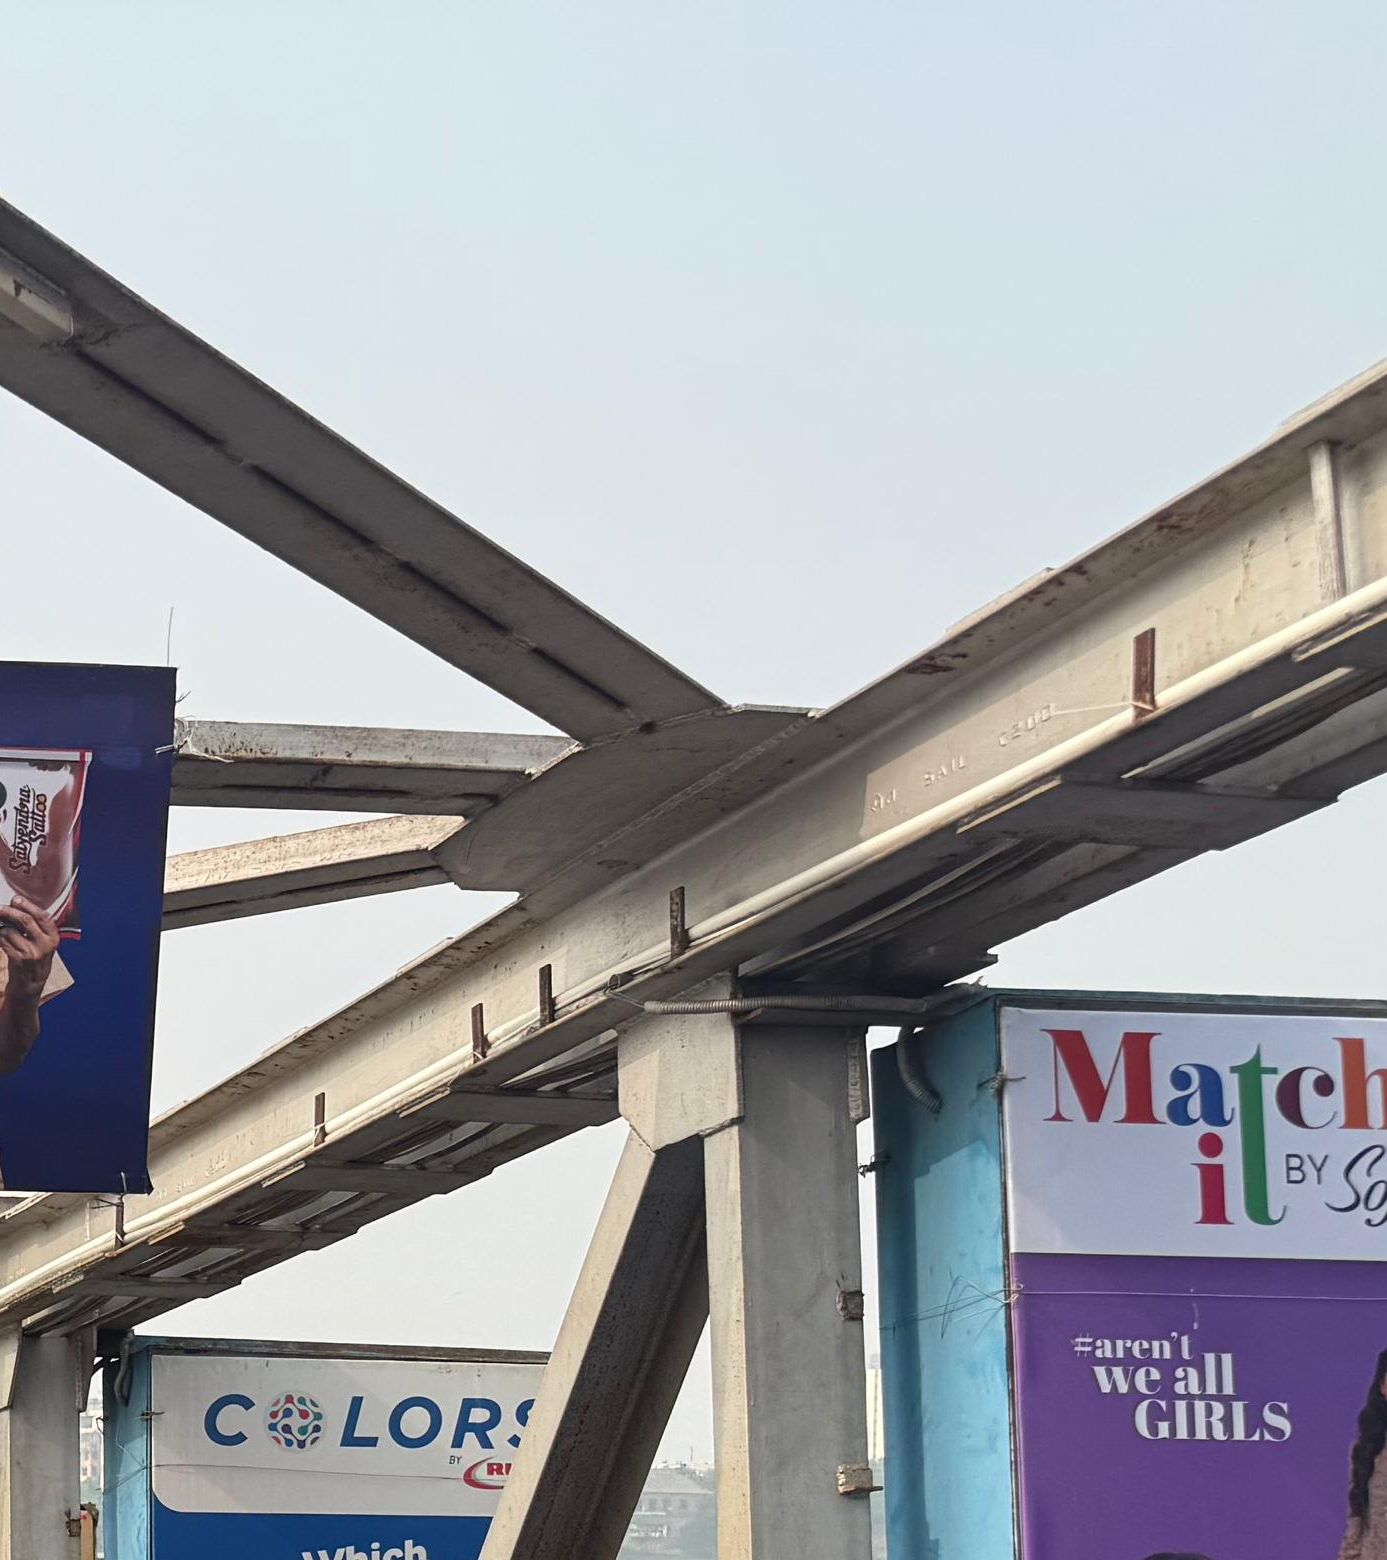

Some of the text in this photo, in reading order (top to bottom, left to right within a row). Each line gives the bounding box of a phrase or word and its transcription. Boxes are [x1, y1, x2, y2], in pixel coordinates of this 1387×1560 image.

[1040, 1028, 1387, 1138] Match
[1285, 1153, 1329, 1186] BY
[1072, 1331, 1194, 1360] #aren't
[1091, 1352, 1237, 1396] we all
[1134, 1399, 1293, 1442] GIRLS
[449, 1455, 463, 1465] BY
